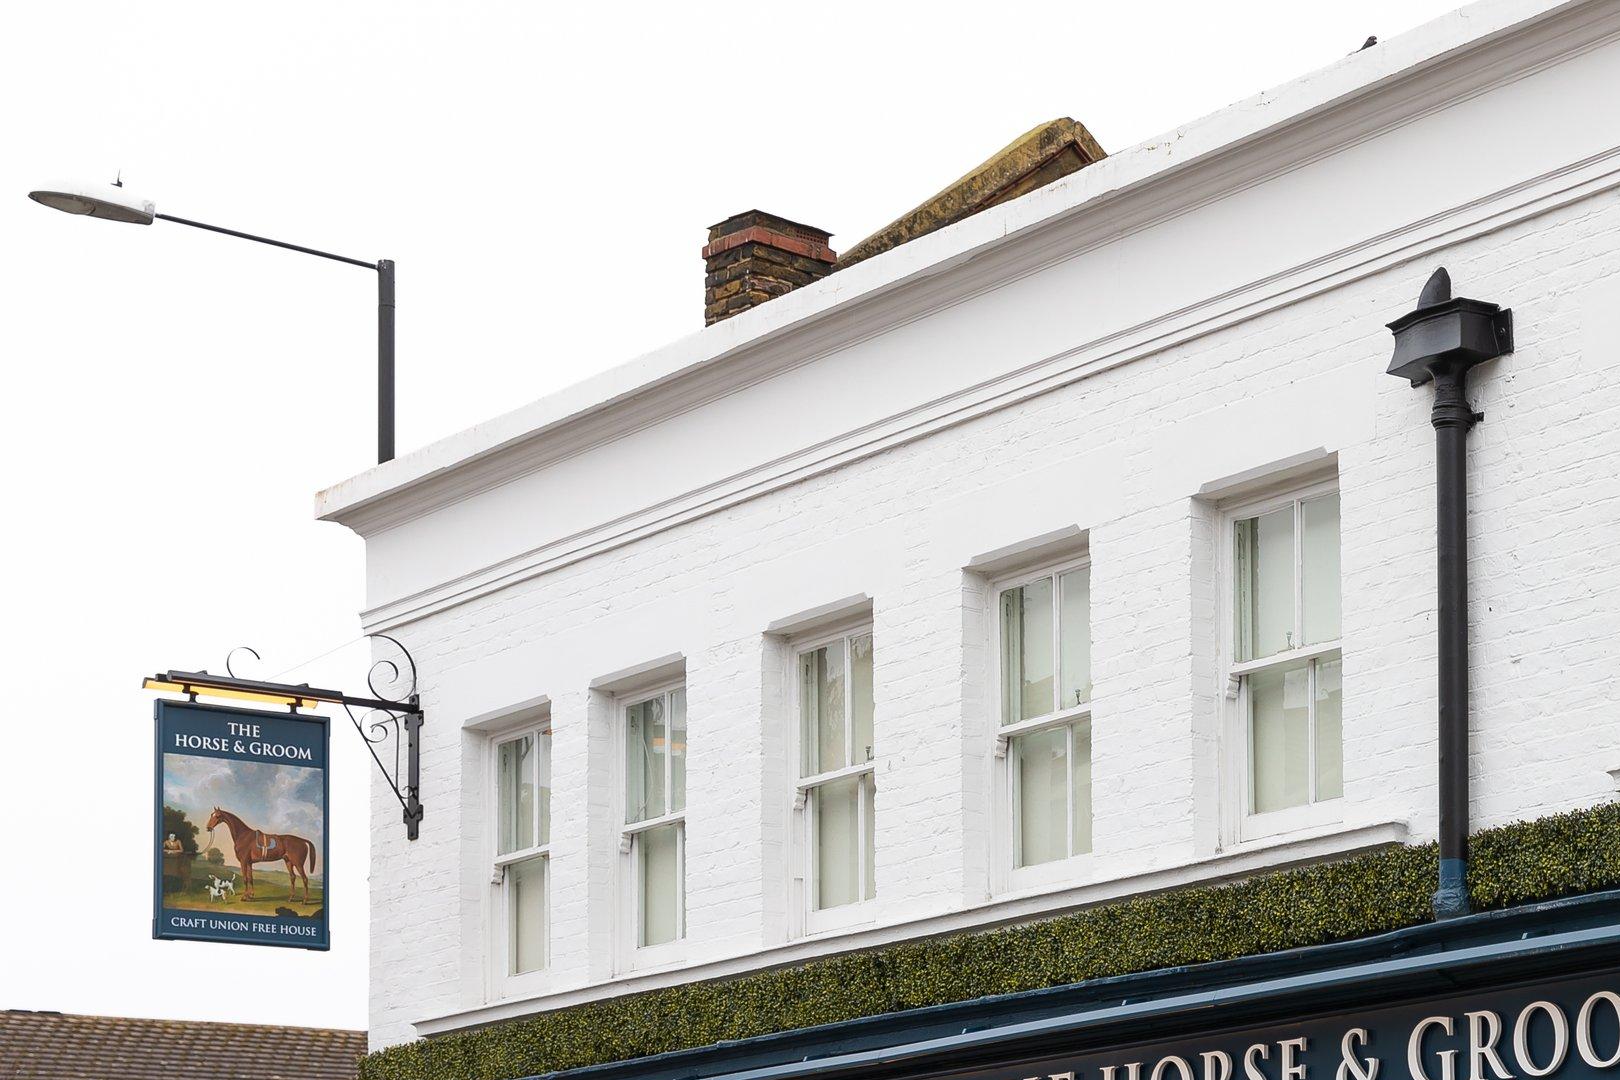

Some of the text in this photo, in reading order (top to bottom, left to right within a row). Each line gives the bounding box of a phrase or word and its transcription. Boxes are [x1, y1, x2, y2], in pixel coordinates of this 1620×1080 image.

[227, 722, 260, 738] THE
[175, 734, 312, 760] HORSE & GROOM
[171, 916, 317, 937] CRAFT UNION FREE HOUSE
